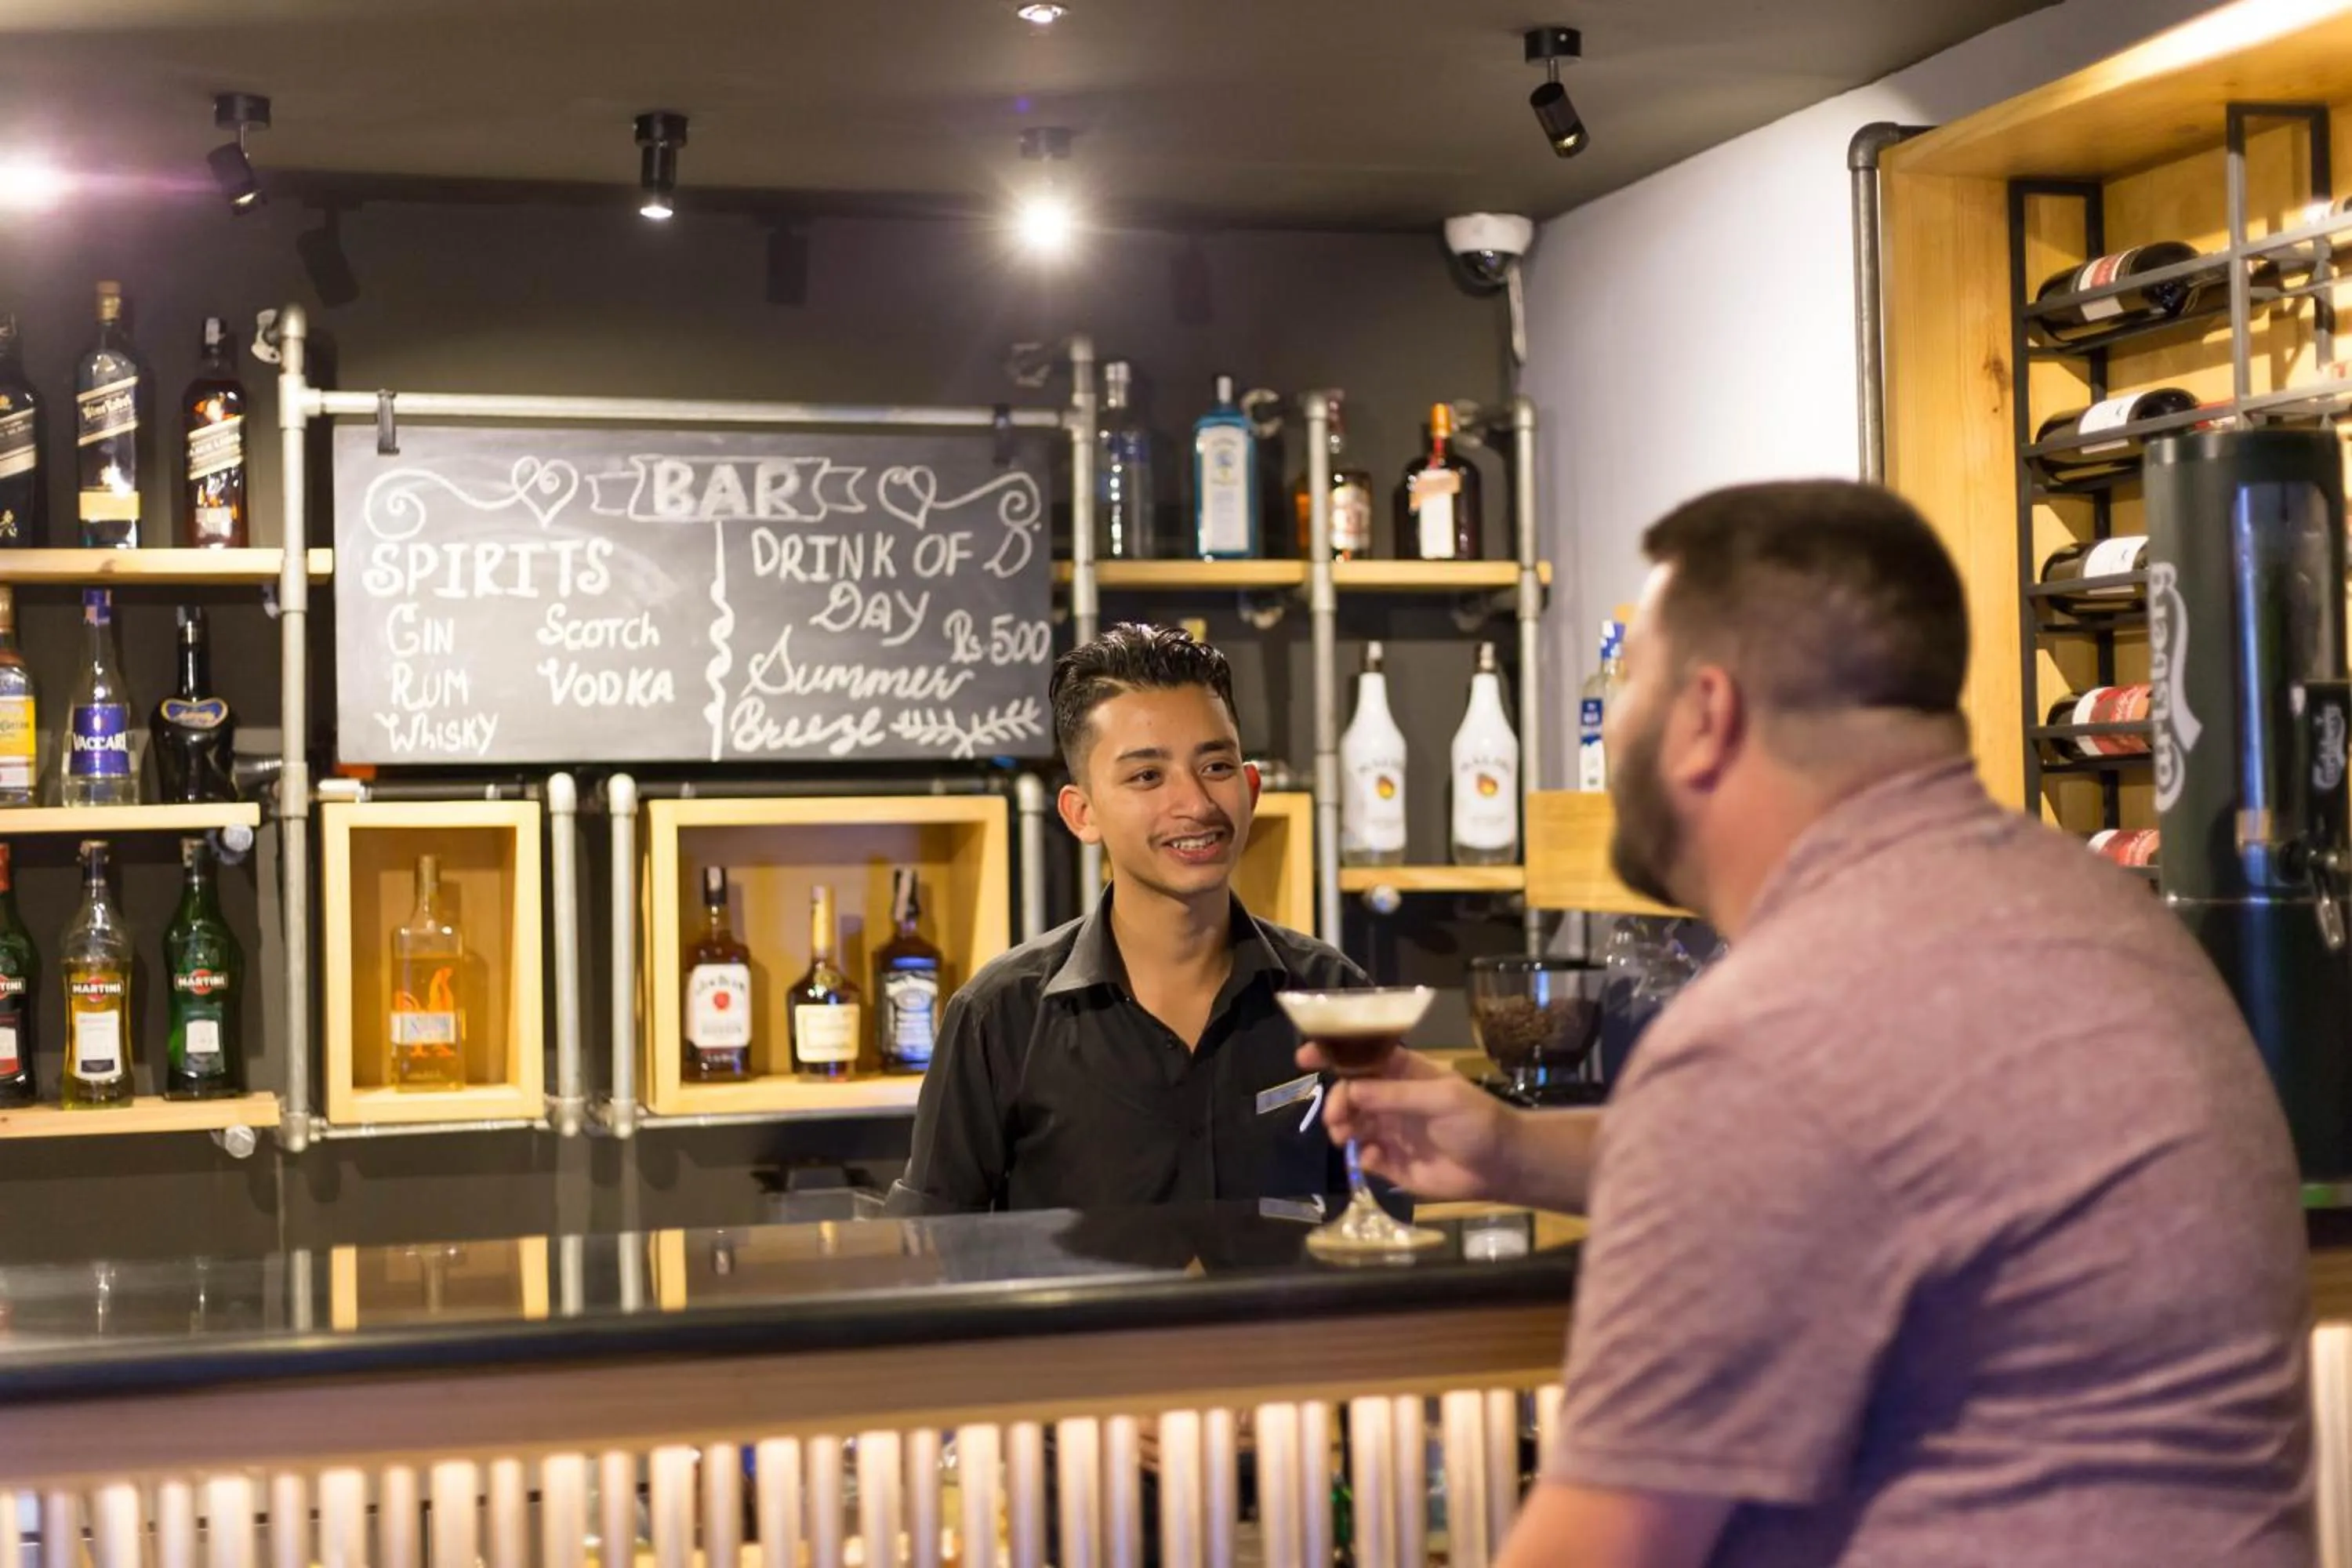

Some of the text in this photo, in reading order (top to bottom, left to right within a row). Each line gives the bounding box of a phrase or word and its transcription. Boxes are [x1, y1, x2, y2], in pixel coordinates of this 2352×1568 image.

[653, 459, 800, 520] BAR
[361, 536, 613, 599] SPIRITS
[750, 526, 897, 583] DRINK
[912, 531, 974, 578] OF
[386, 601, 455, 658] GIN
[809, 580, 931, 647] DAY
[390, 661, 470, 712] RUM
[536, 657, 676, 708] VODKA
[739, 623, 976, 701] Summer
[730, 695, 887, 757] Breeze
[0, 980, 23, 992] TINI
[72, 982, 122, 994] MARTINI
[177, 975, 226, 987] MARTINI
